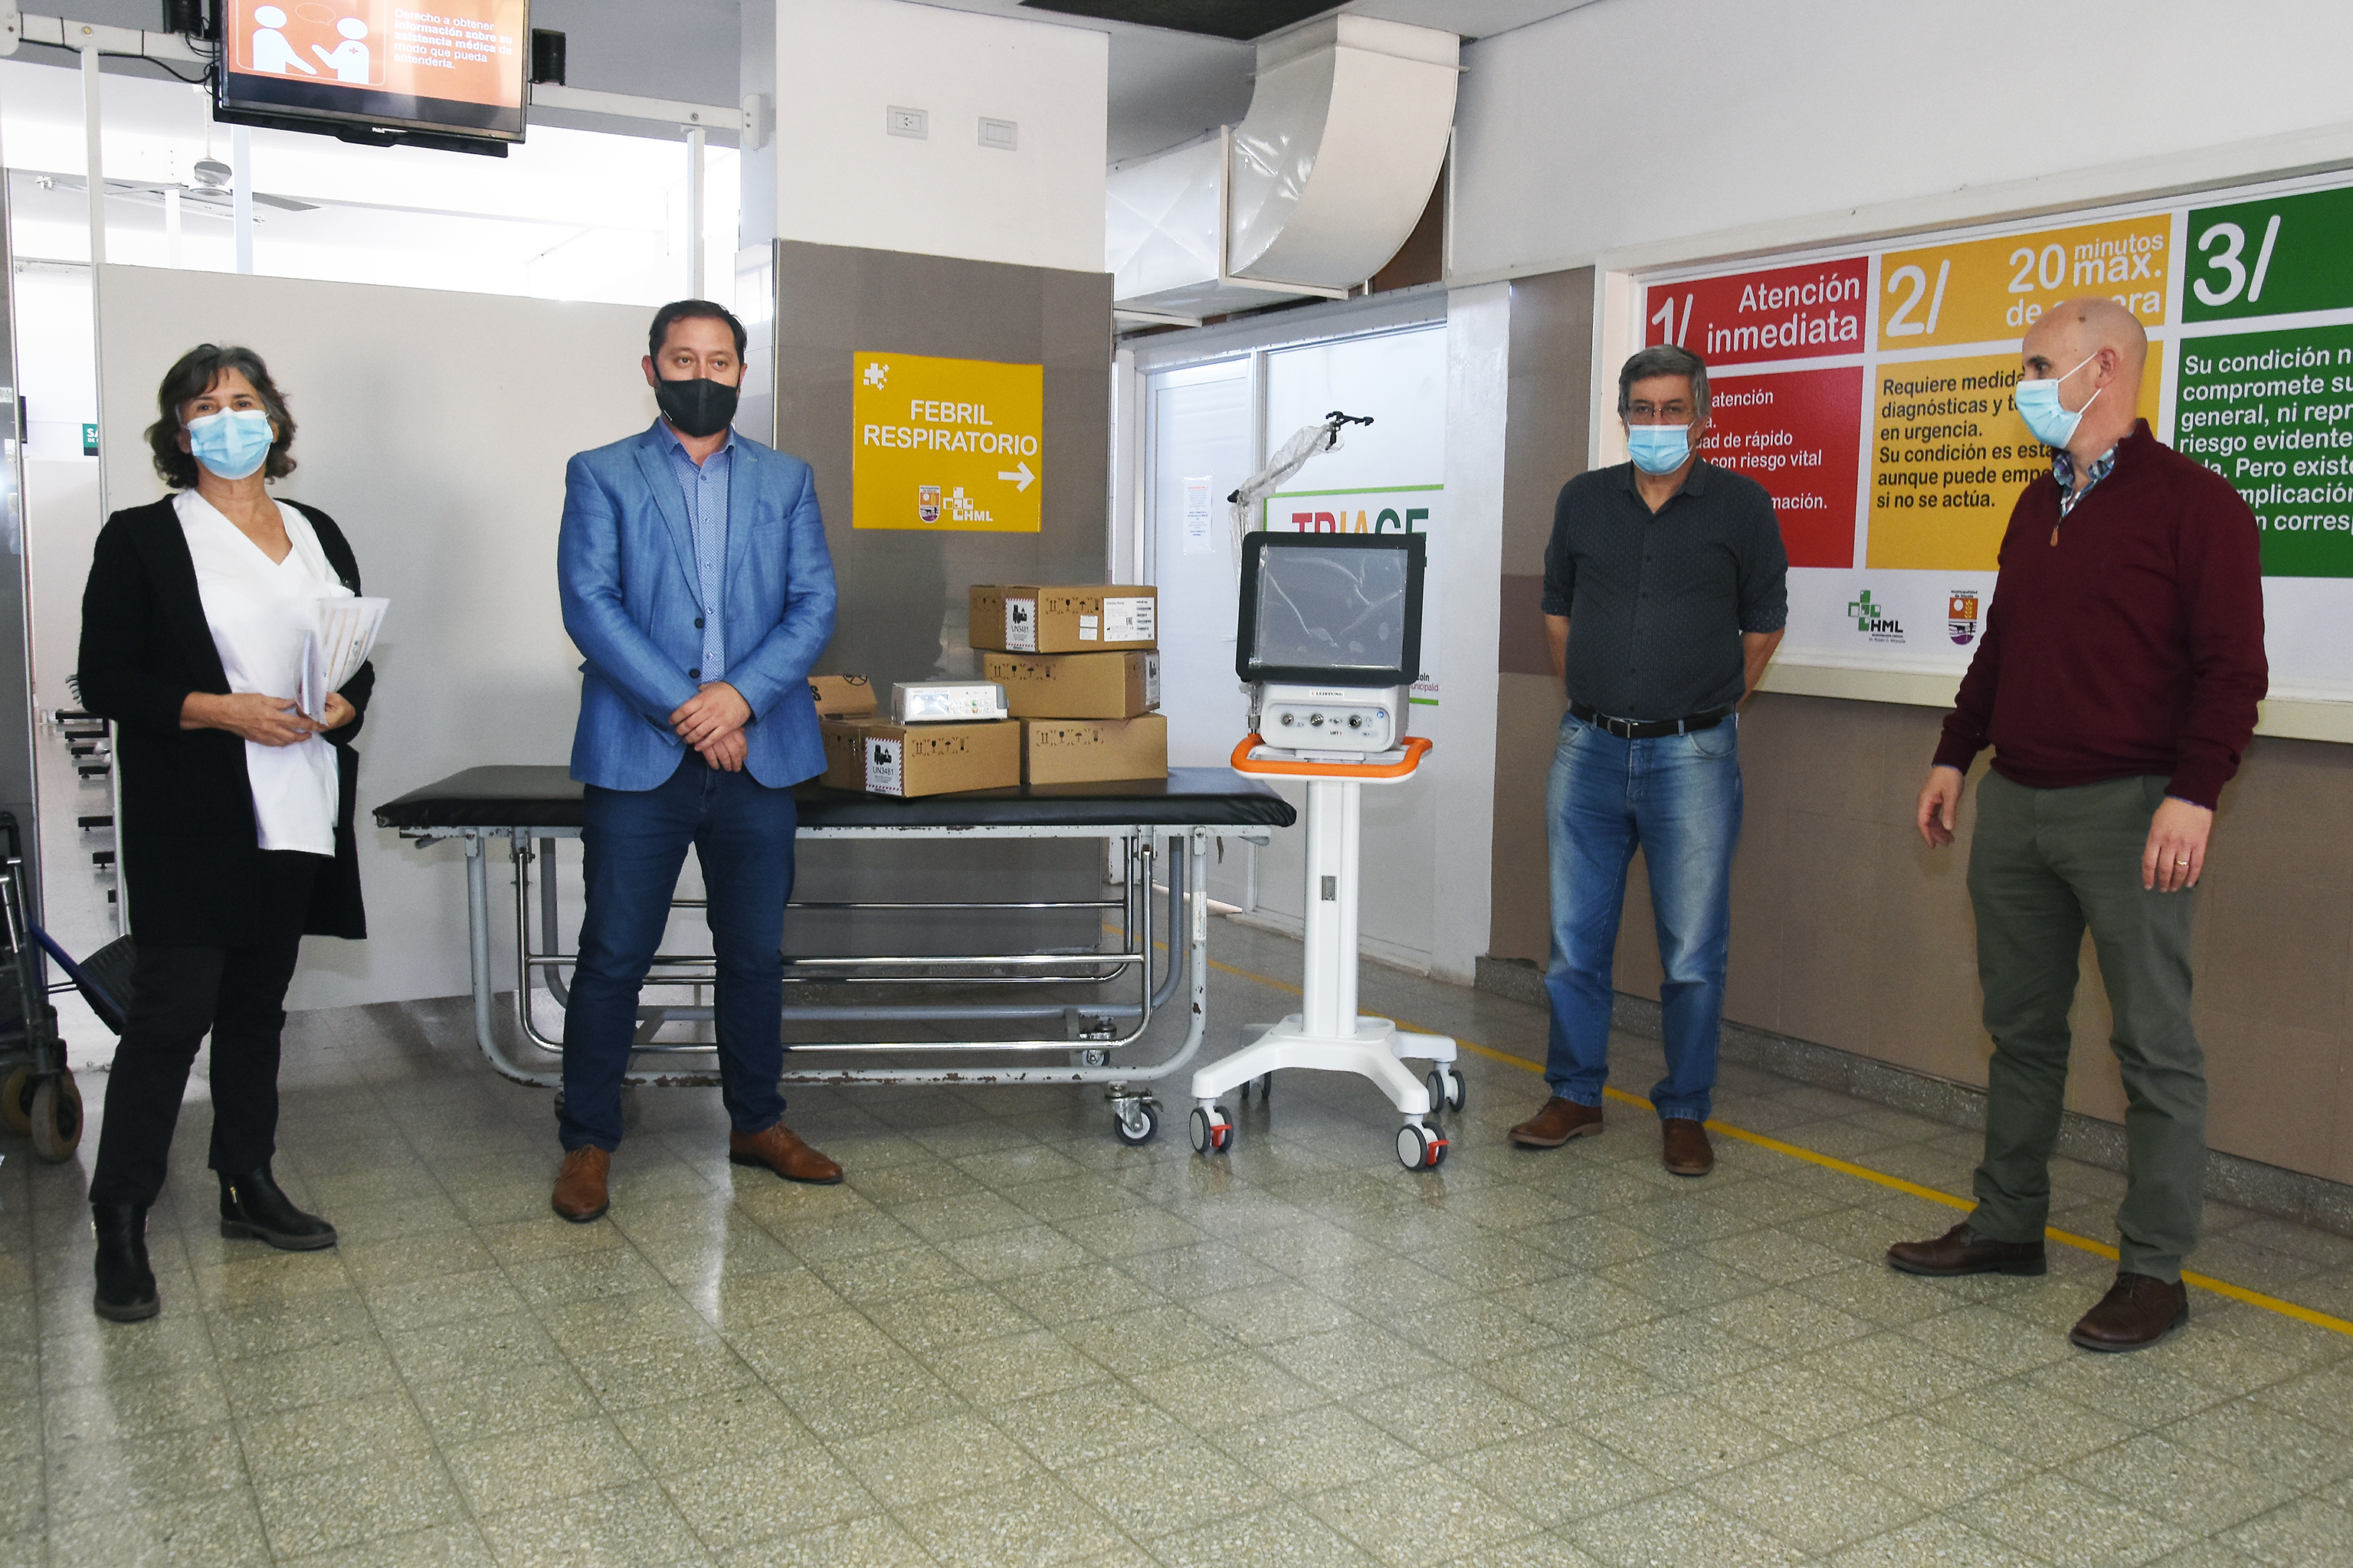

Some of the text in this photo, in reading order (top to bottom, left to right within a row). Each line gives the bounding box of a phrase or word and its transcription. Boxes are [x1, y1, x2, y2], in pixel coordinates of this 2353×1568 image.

[395, 8, 441, 24] Derecho
[453, 18, 494, 31] obtener
[395, 20, 513, 44] información sobre su
[395, 31, 513, 55] asistencia médica de
[394, 42, 488, 63] modo que pueda
[394, 53, 456, 69] entenderla.
[2008, 234, 2164, 293] 20 minutos
[2073, 253, 2161, 286] max.
[2193, 214, 2281, 306] 3/
[1739, 273, 1860, 313] Atención
[1886, 260, 1950, 337] 2/
[2006, 298, 2042, 327] de
[1707, 309, 1857, 354] inmediata
[2184, 346, 2353, 375] Su condición n
[1712, 389, 1773, 408] atención
[1883, 376, 1956, 398] Requiere
[2183, 374, 2325, 404] compromete
[911, 399, 993, 425] FEBRIL
[1882, 398, 1988, 421] diagnósticas
[1993, 398, 2003, 417] y
[2181, 403, 2269, 433] general,
[2277, 401, 2297, 423] ni
[864, 424, 1037, 457] RESPIRATORIO
[1724, 432, 1741, 448] de
[1745, 430, 1793, 450] rápido
[1880, 421, 1982, 443] en urgencia.
[2180, 427, 2353, 457] riesgo evidente
[1740, 453, 1786, 471] riesgo
[1791, 450, 1822, 466] vital
[1879, 447, 1899, 463] Su
[1904, 444, 1986, 463] condición
[1992, 445, 2012, 459] es
[1878, 472, 1938, 489] aunque
[1943, 466, 1996, 489] puede
[2236, 457, 2286, 479] Pero
[1876, 489, 1995, 509] si no se actúa.
[965, 510, 993, 522] HML
[2274, 515, 2353, 535] corres
[1011, 625, 1029, 633] UN3481
[1870, 619, 1903, 633] HML
[873, 766, 894, 775] UN3481
